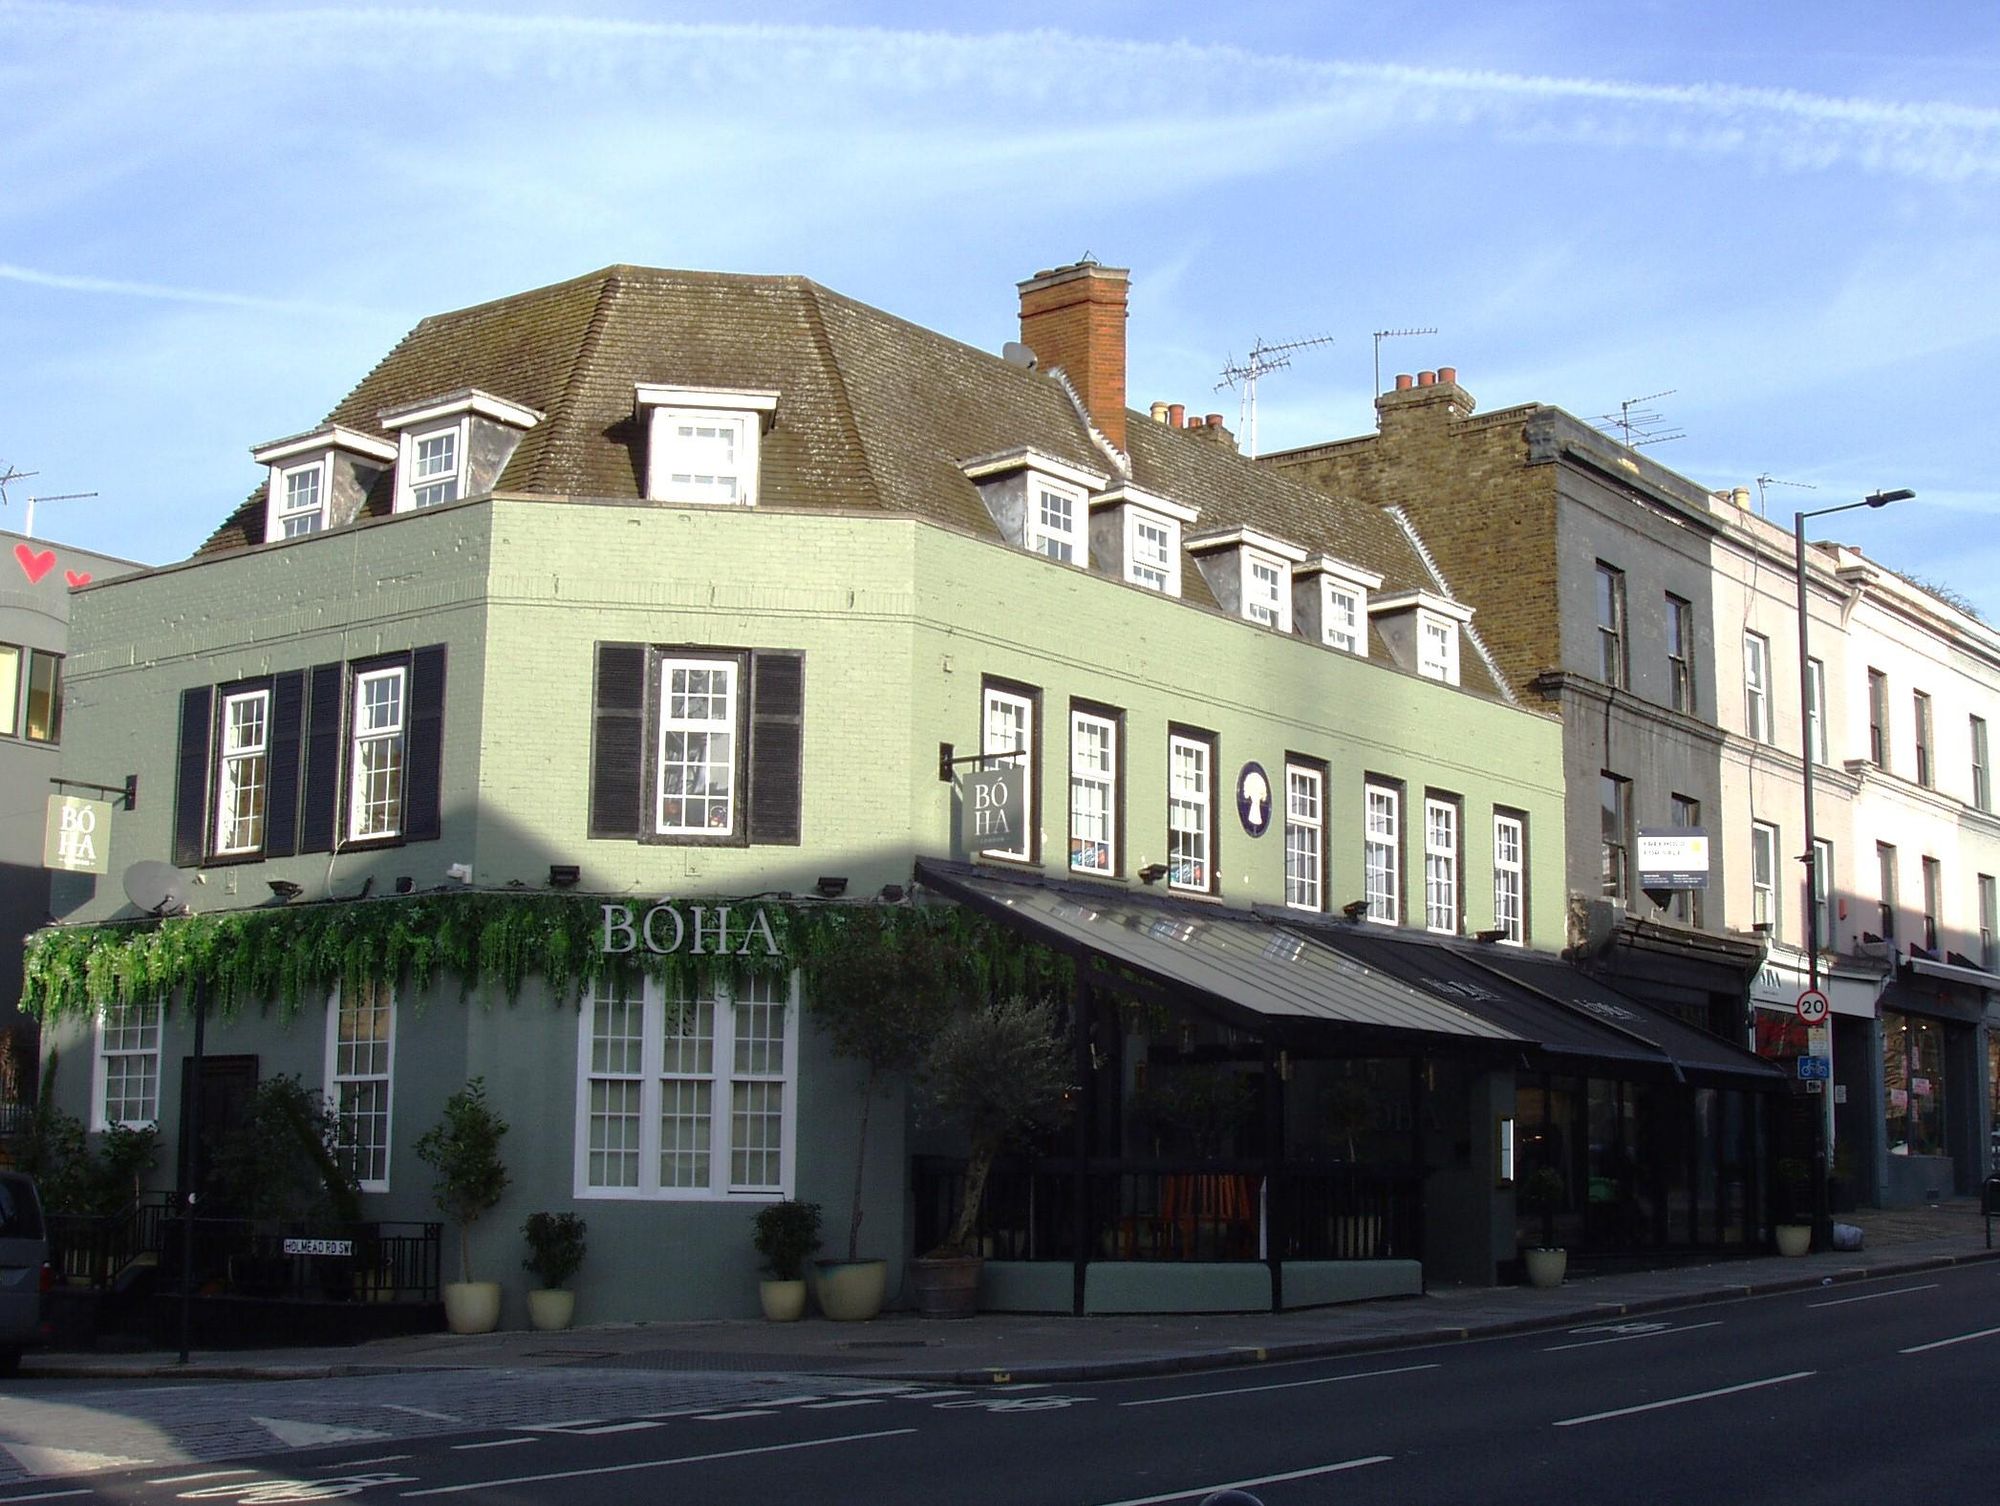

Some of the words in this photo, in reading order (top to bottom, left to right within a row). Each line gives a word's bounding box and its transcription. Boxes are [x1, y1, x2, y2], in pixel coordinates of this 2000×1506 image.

[974, 777, 1008, 809] BÓ
[59, 805, 96, 833] BÓ
[974, 809, 1010, 835] HA
[58, 831, 96, 859] HA
[601, 896, 782, 955] BÓHA
[1802, 1000, 1824, 1014] 20
[285, 1240, 324, 1254] HOLMEAD
[326, 1242, 337, 1254] RD
